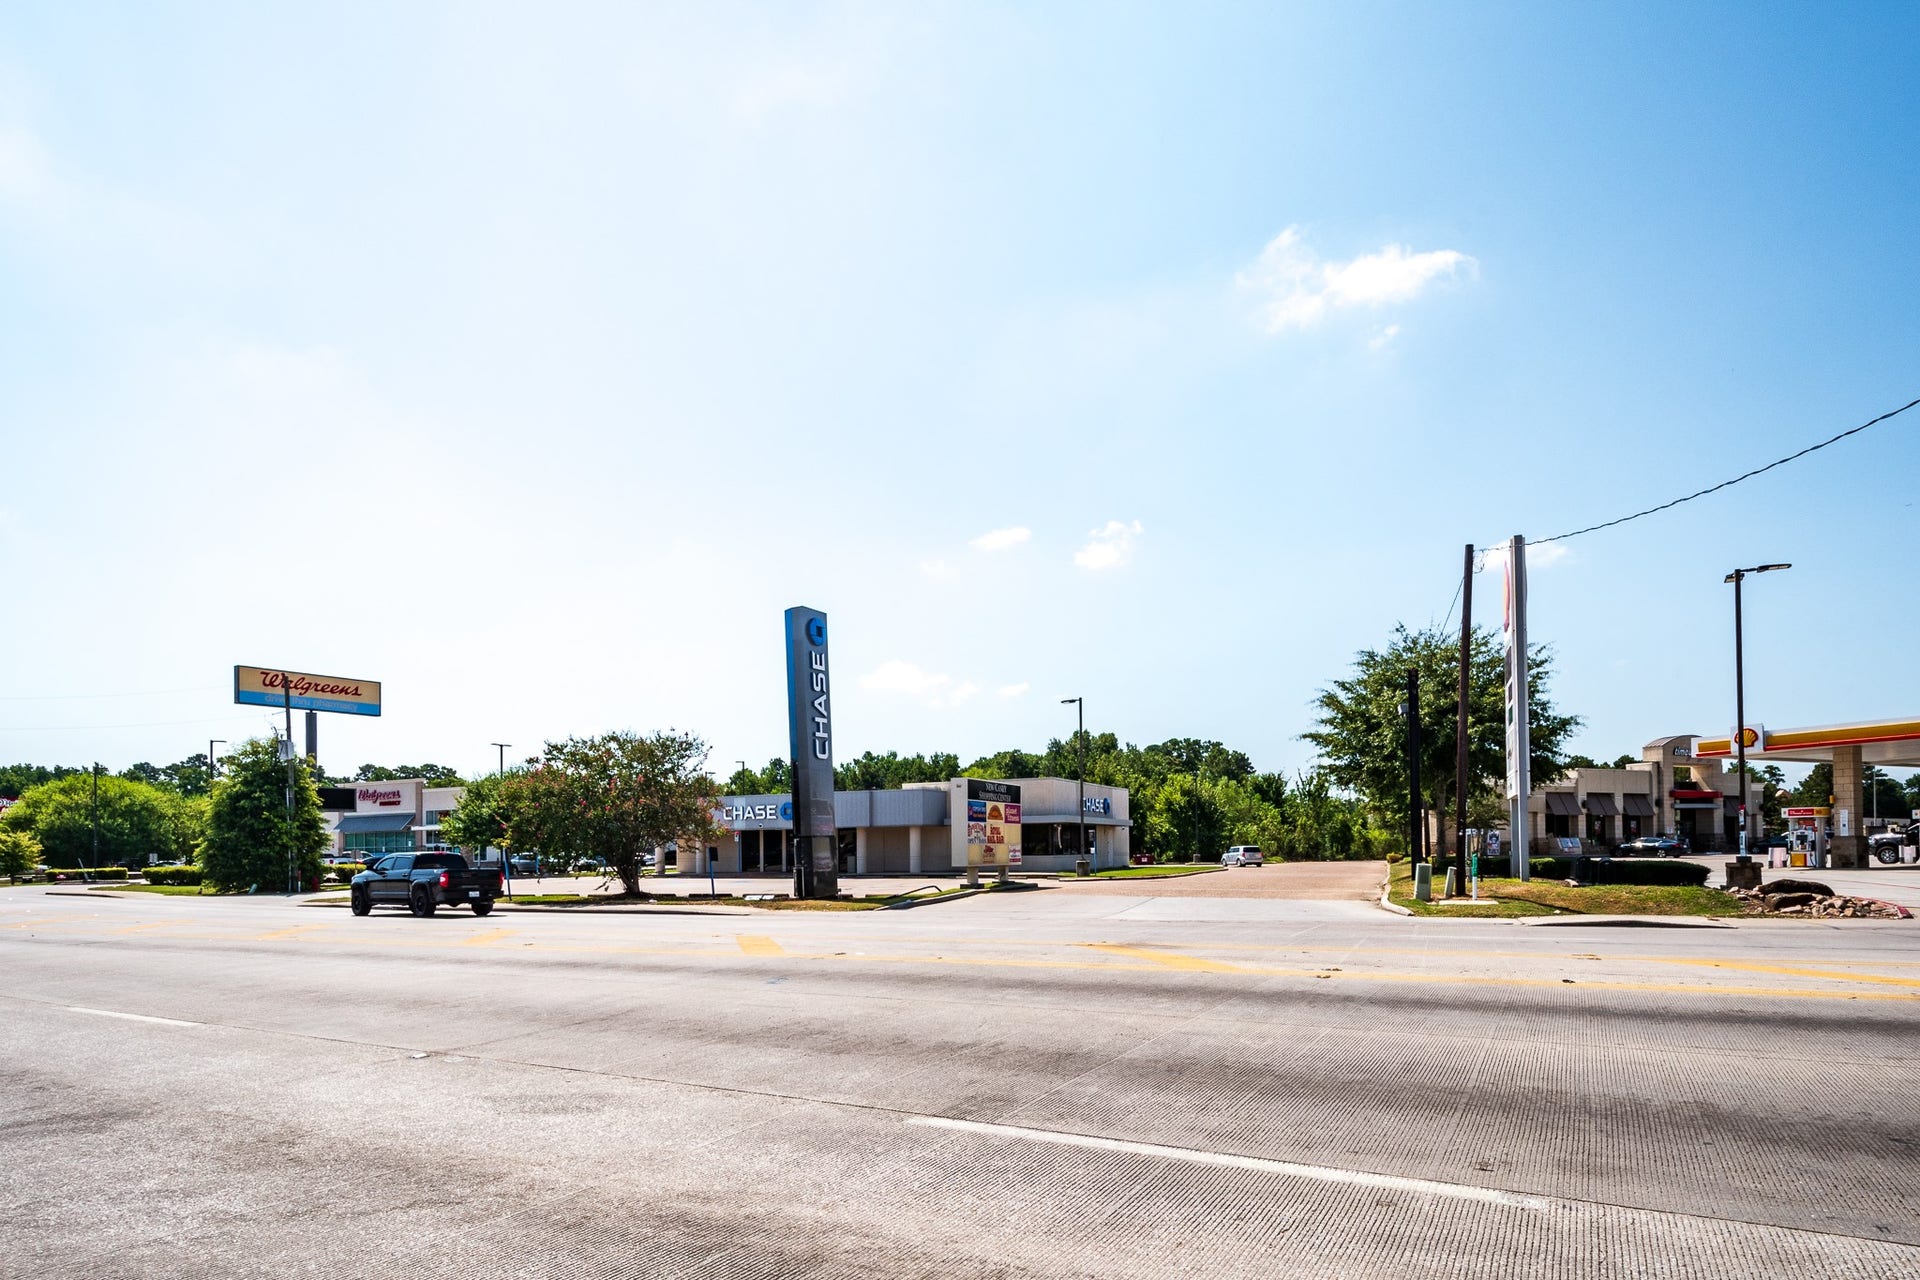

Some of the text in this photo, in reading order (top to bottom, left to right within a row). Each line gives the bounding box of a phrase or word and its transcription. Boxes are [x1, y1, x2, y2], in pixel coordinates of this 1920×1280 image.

[260, 671, 362, 696] Walgreens
[812, 650, 829, 760] CHASE
[359, 789, 401, 804] Walgreens
[723, 805, 777, 821] CHASE
